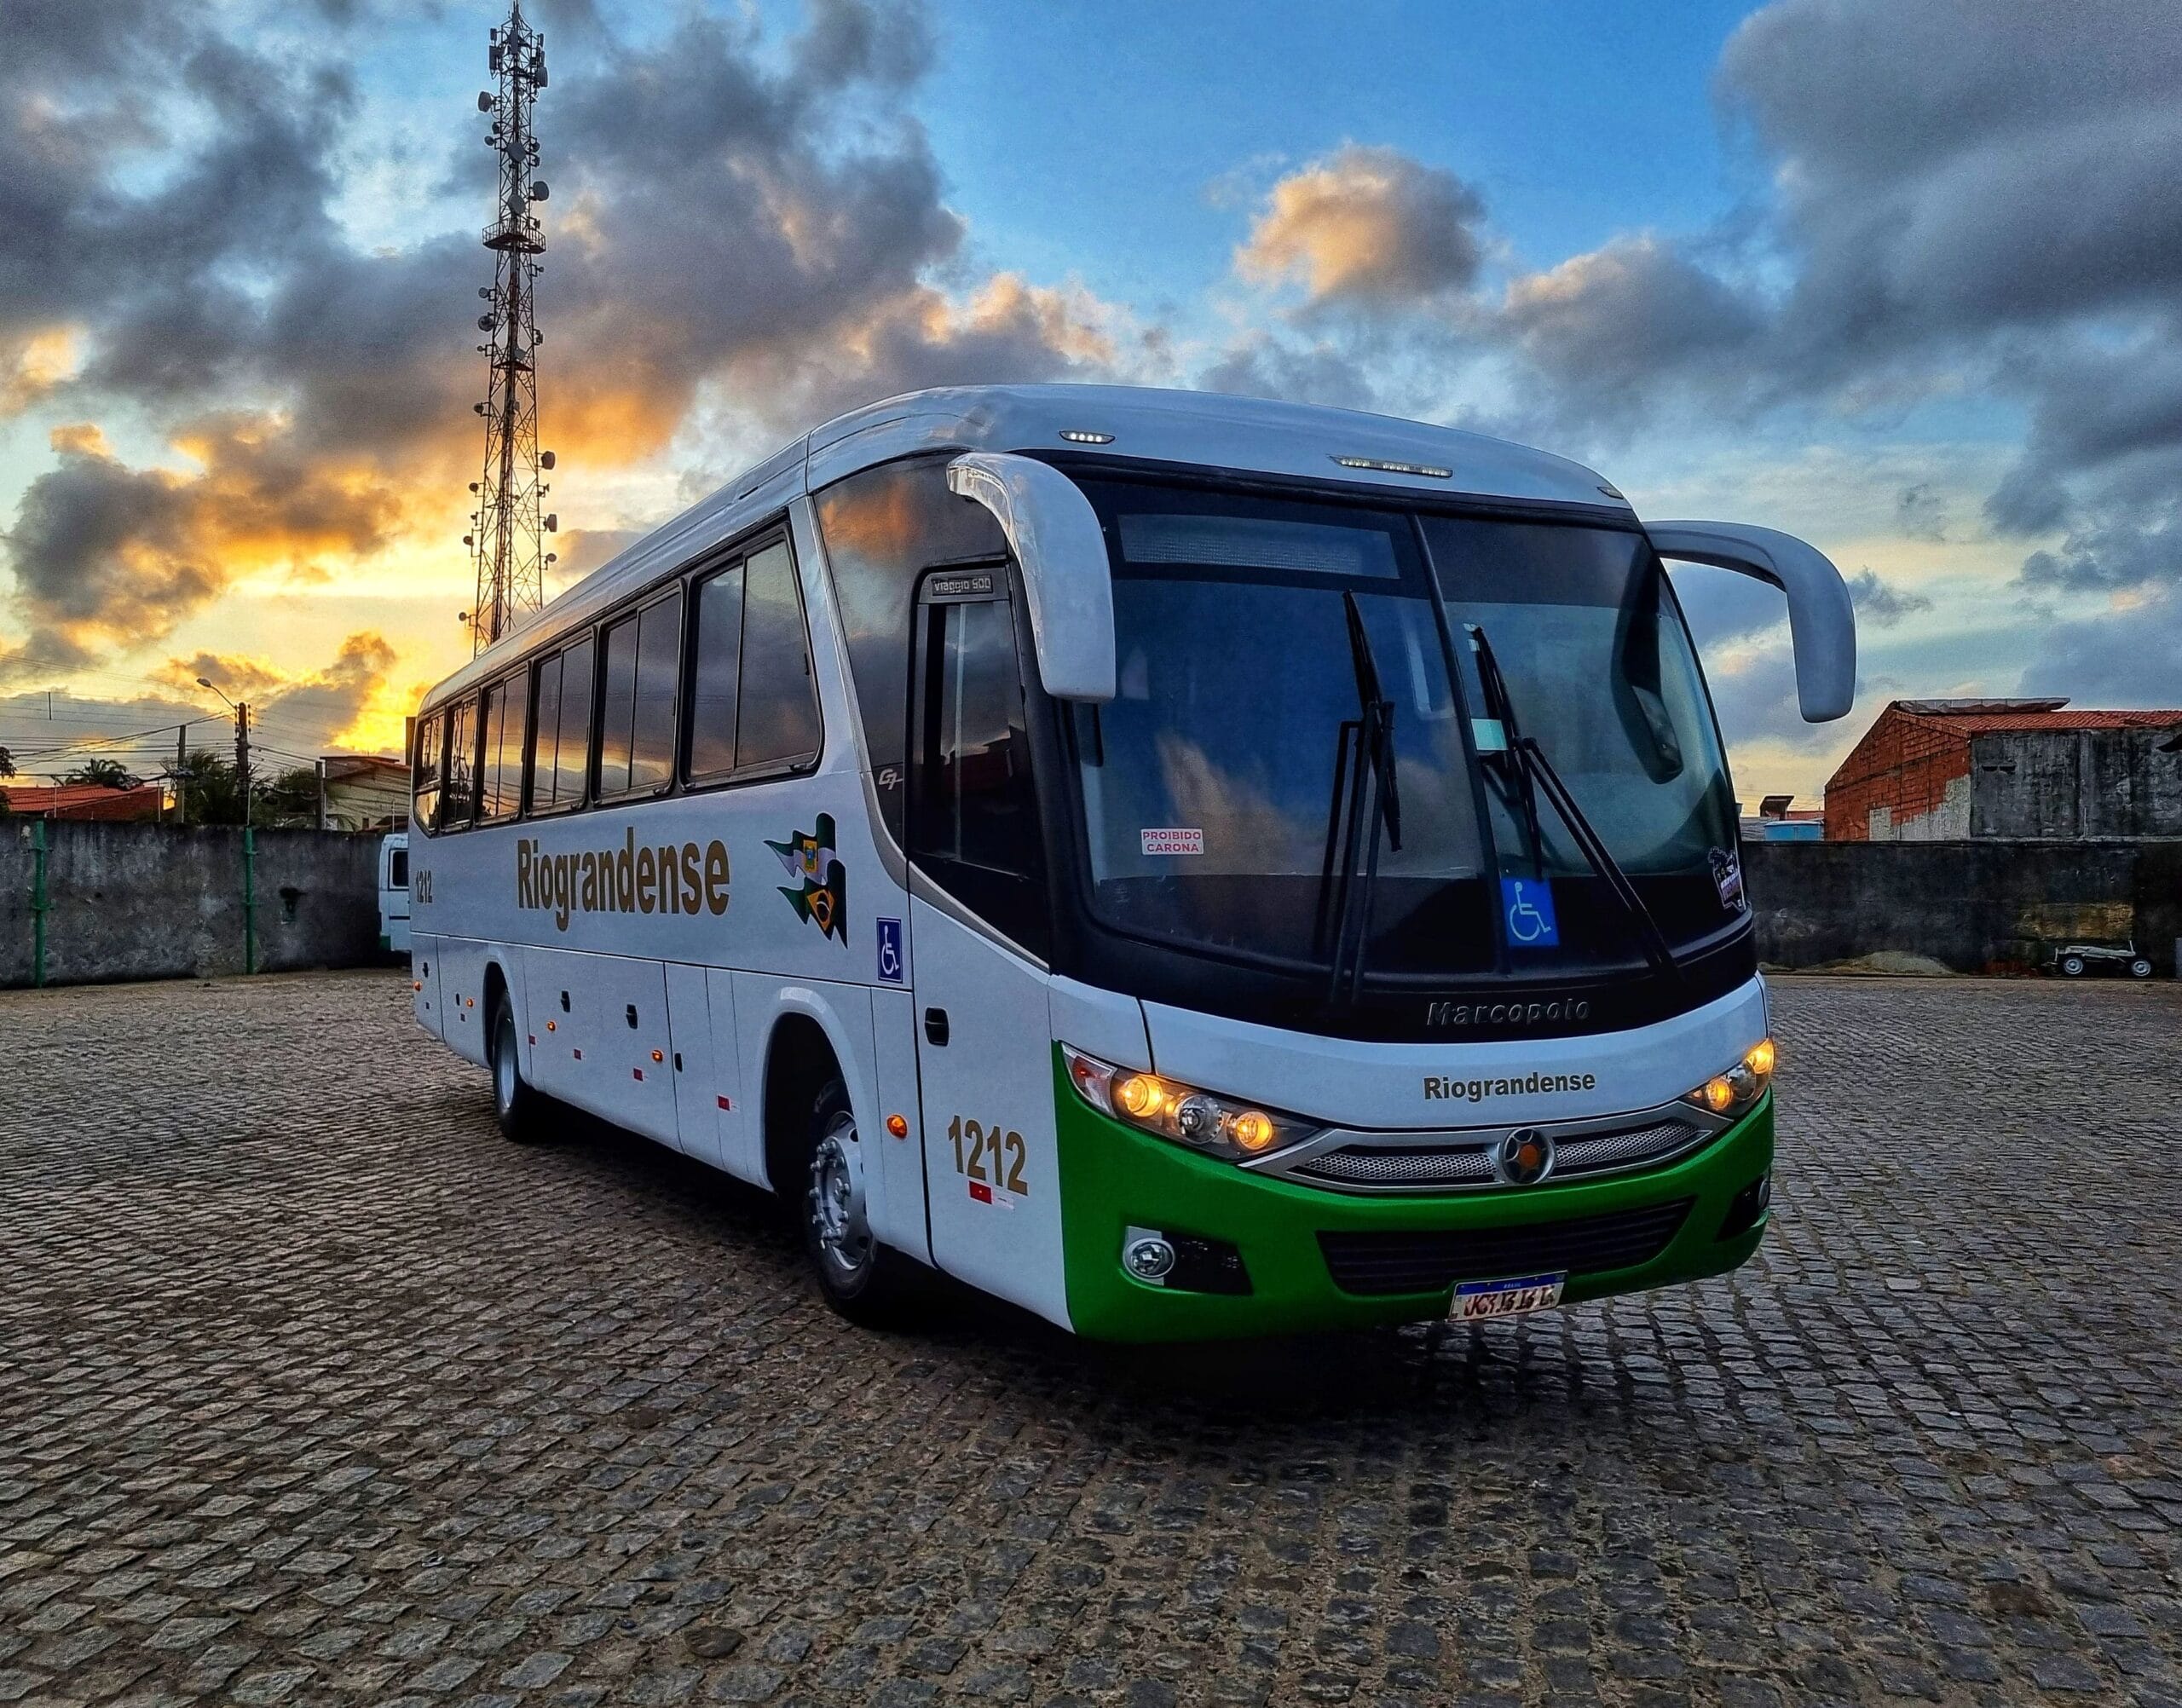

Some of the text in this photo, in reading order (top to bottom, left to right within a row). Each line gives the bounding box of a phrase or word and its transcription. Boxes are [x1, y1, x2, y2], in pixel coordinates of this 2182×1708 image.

[1143, 831, 1201, 840] PROIBIDO
[1146, 843, 1199, 852] CARONA
[415, 869, 433, 904] 1212
[517, 826, 730, 932] Riograndense
[1426, 998, 1591, 1026] Marcopolo
[1423, 1071, 1596, 1103] Riograndense
[947, 1114, 1029, 1197] 1212
